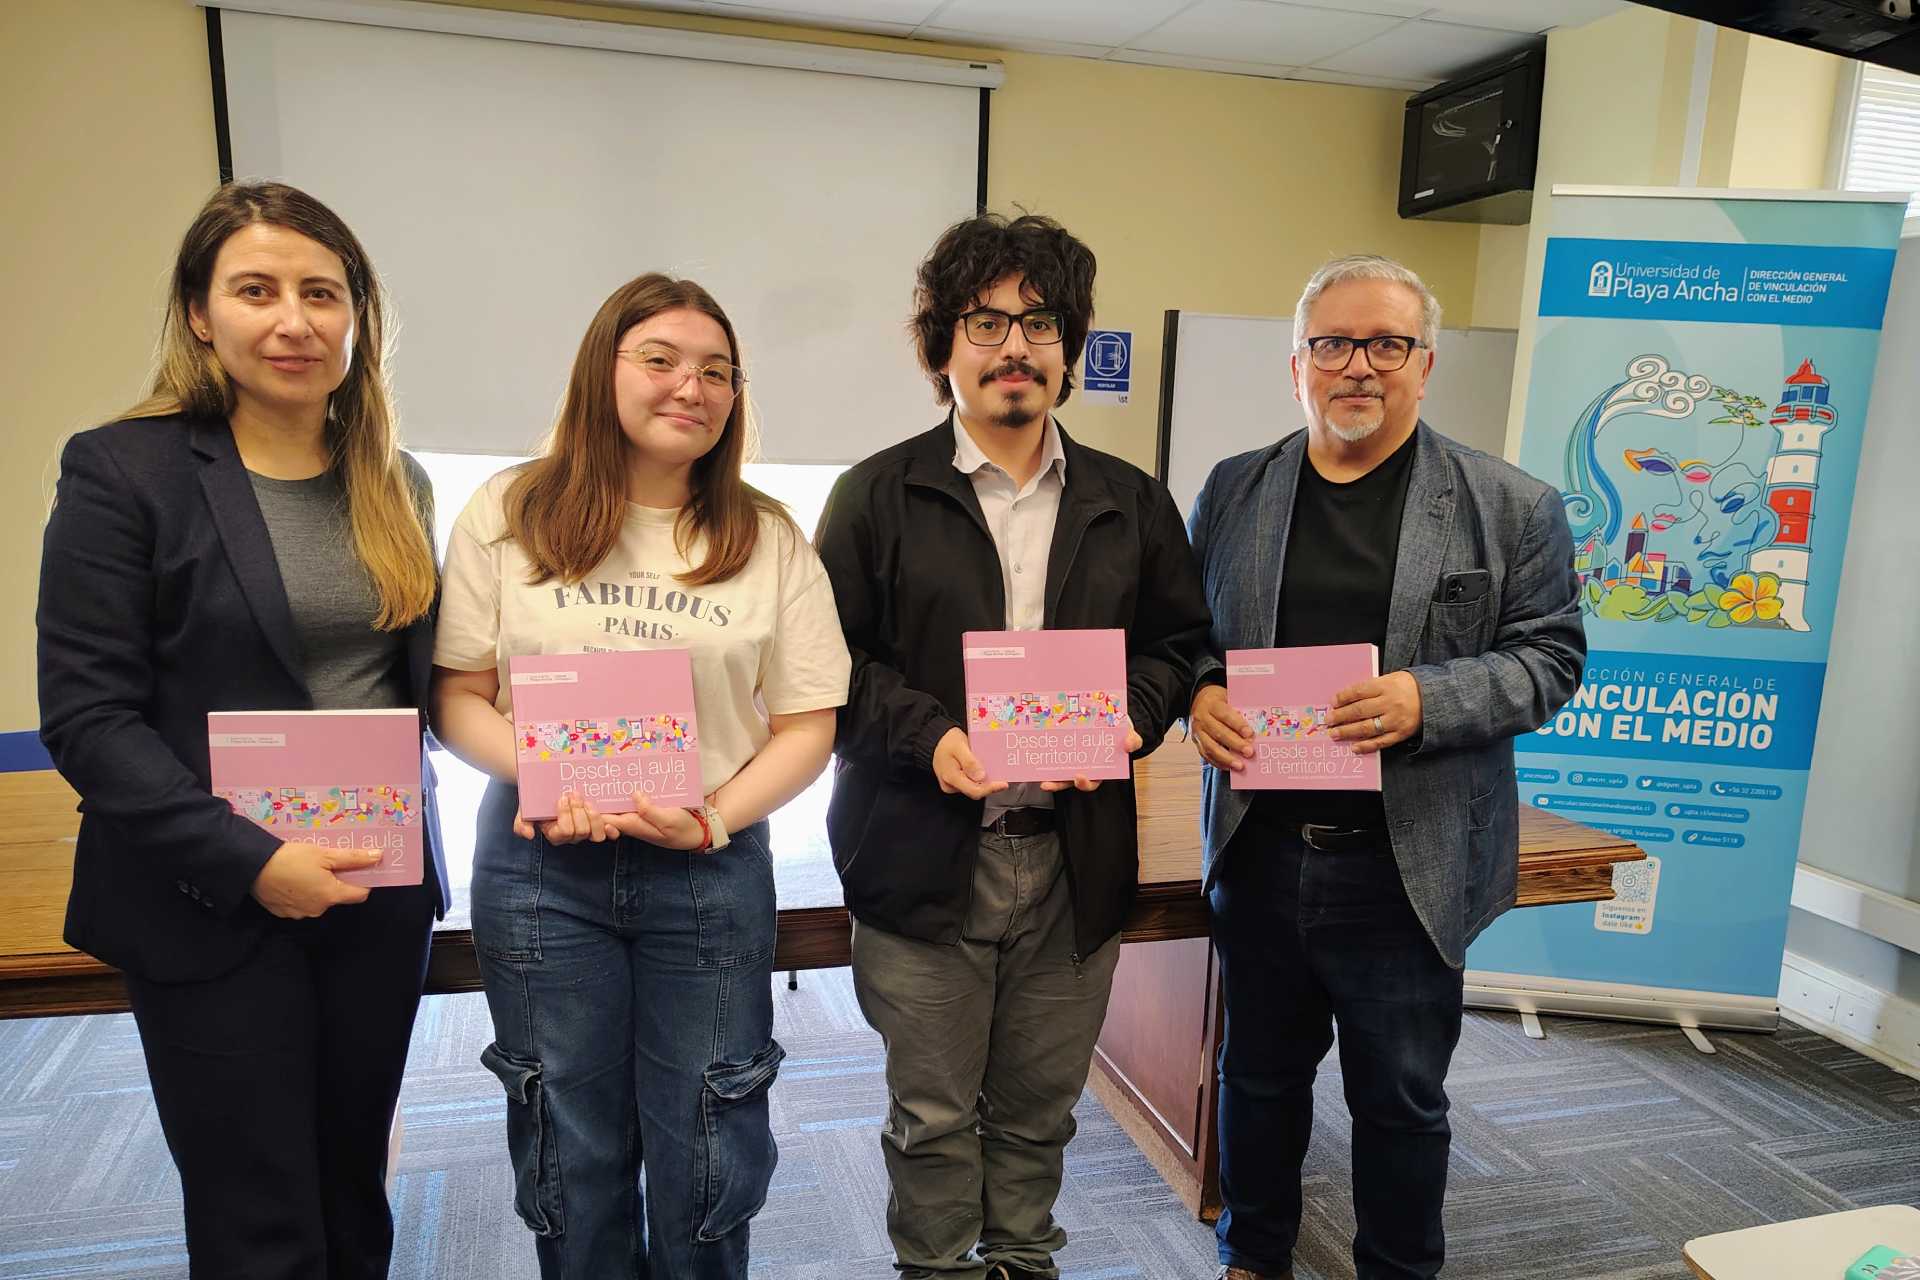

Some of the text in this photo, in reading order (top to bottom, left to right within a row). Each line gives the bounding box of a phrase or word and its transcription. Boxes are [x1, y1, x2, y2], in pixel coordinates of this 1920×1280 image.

[1615, 262, 1720, 280] Universidad de
[1750, 269, 1849, 282] DIRECCIÓN GENERAL
[1612, 277, 1738, 304] Playa Ancha
[1748, 281, 1828, 293] DE VINCULACIÓN
[1746, 293, 1813, 304] CON EL MEDIO
[629, 571, 646, 579] YOUR
[553, 581, 731, 627] FABULOUS
[602, 616, 673, 641] PARIS
[1586, 667, 1776, 691] CCIÓN GENERAL DE
[1563, 683, 1778, 721] NCULACIÓN
[1005, 728, 1115, 749] Desde el aula
[1610, 714, 1652, 742] EL
[1661, 717, 1773, 750] MEDIO
[1007, 749, 1020, 766] al
[1025, 749, 1088, 765] territorio
[1104, 747, 1115, 763] 2
[1259, 742, 1363, 760] Desde el aul
[560, 756, 686, 780] Desde el aula
[1260, 760, 1272, 774] al
[1277, 758, 1337, 775] territorio
[1352, 758, 1364, 773] 2
[583, 775, 656, 797] territorio
[674, 773, 688, 790] 2
[337, 831, 354, 849] el
[362, 830, 404, 848] aula
[391, 848, 404, 866] 2
